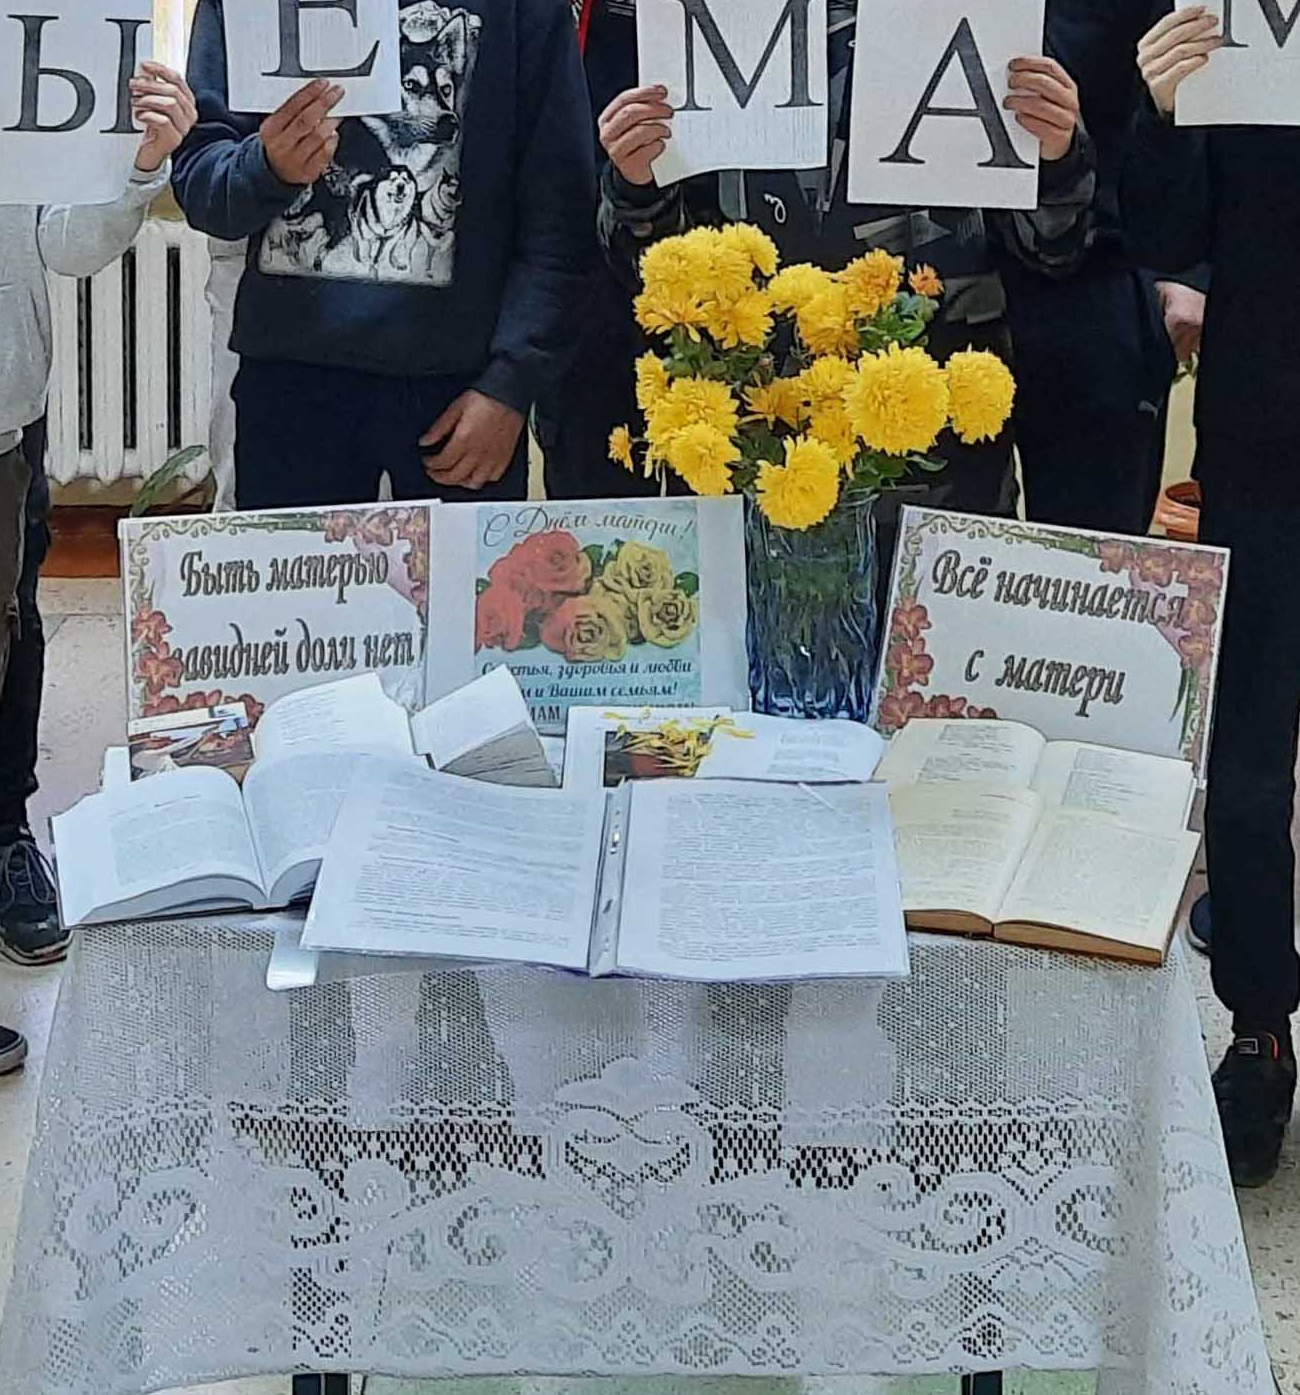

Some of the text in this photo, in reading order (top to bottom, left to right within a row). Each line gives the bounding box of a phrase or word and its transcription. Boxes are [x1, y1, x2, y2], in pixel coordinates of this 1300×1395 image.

[2, 15, 148, 134] Ы
[879, 17, 1035, 169] А
[180, 550, 390, 605] Быть матерью
[932, 549, 1188, 631] Всё начинается
[296, 617, 357, 673] доли
[363, 628, 415, 668] нет
[995, 655, 1127, 717] матери
